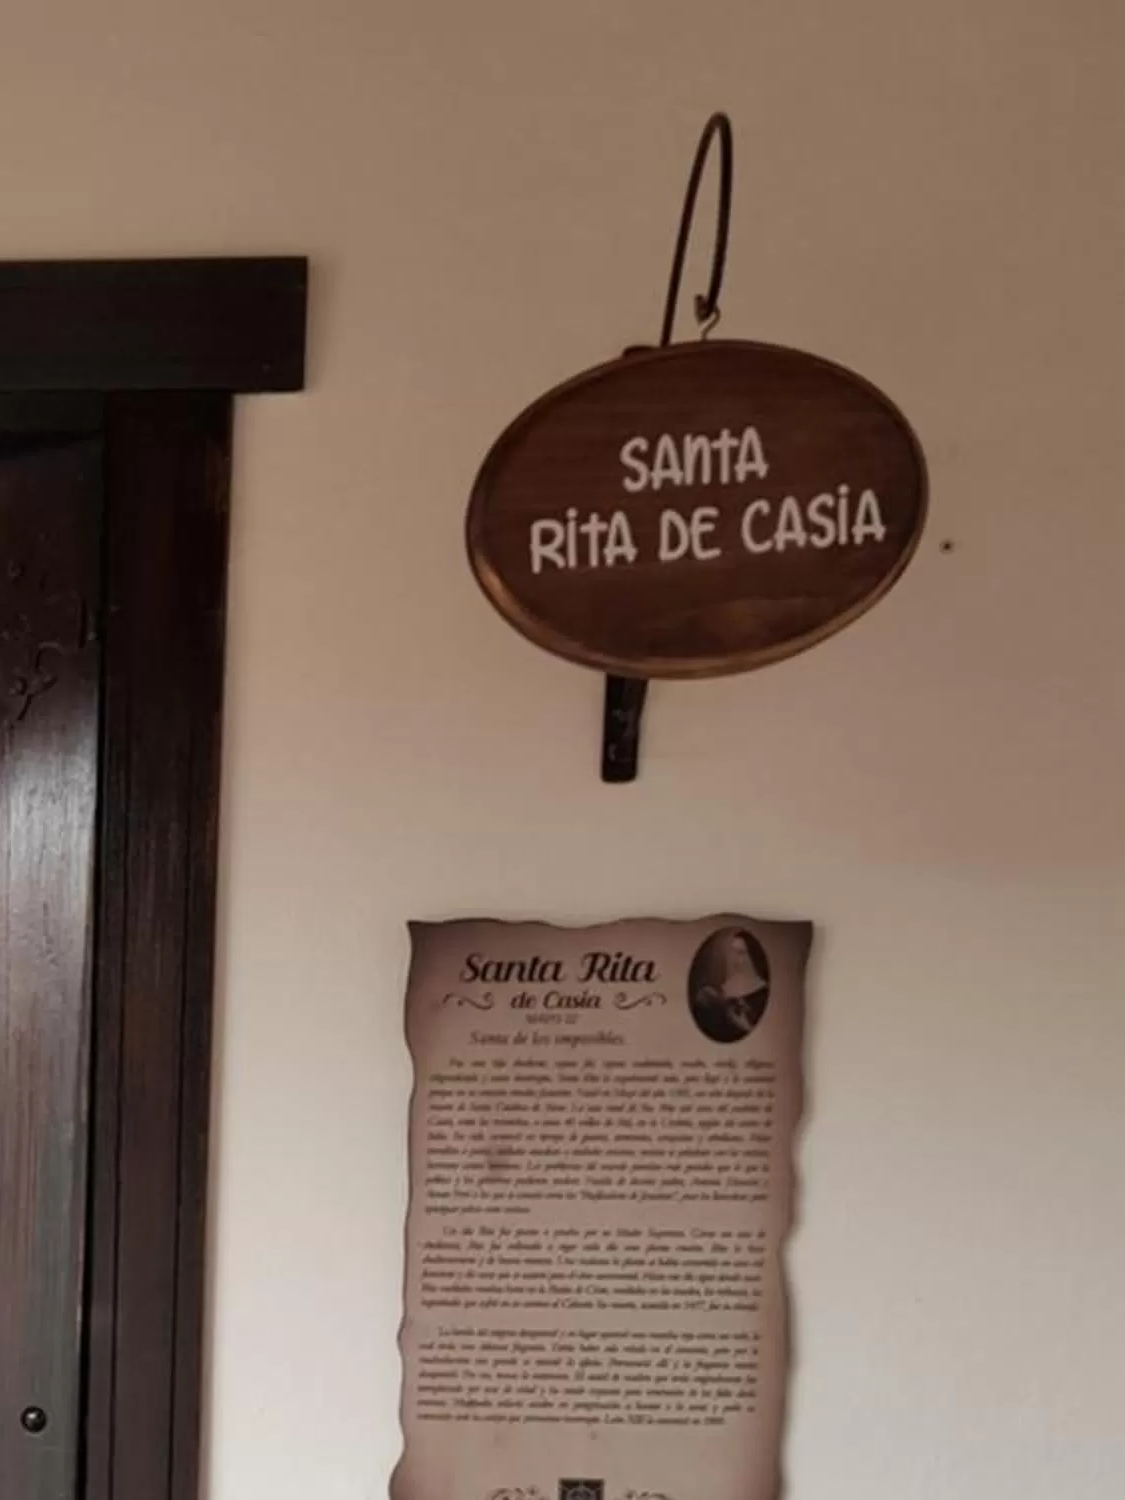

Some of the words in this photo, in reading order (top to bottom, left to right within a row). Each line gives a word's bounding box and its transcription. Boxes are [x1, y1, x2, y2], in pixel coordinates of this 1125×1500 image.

[658, 507, 722, 563] DE
[459, 952, 569, 984] Santa
[577, 951, 662, 984] Rita
[510, 991, 537, 1009] de
